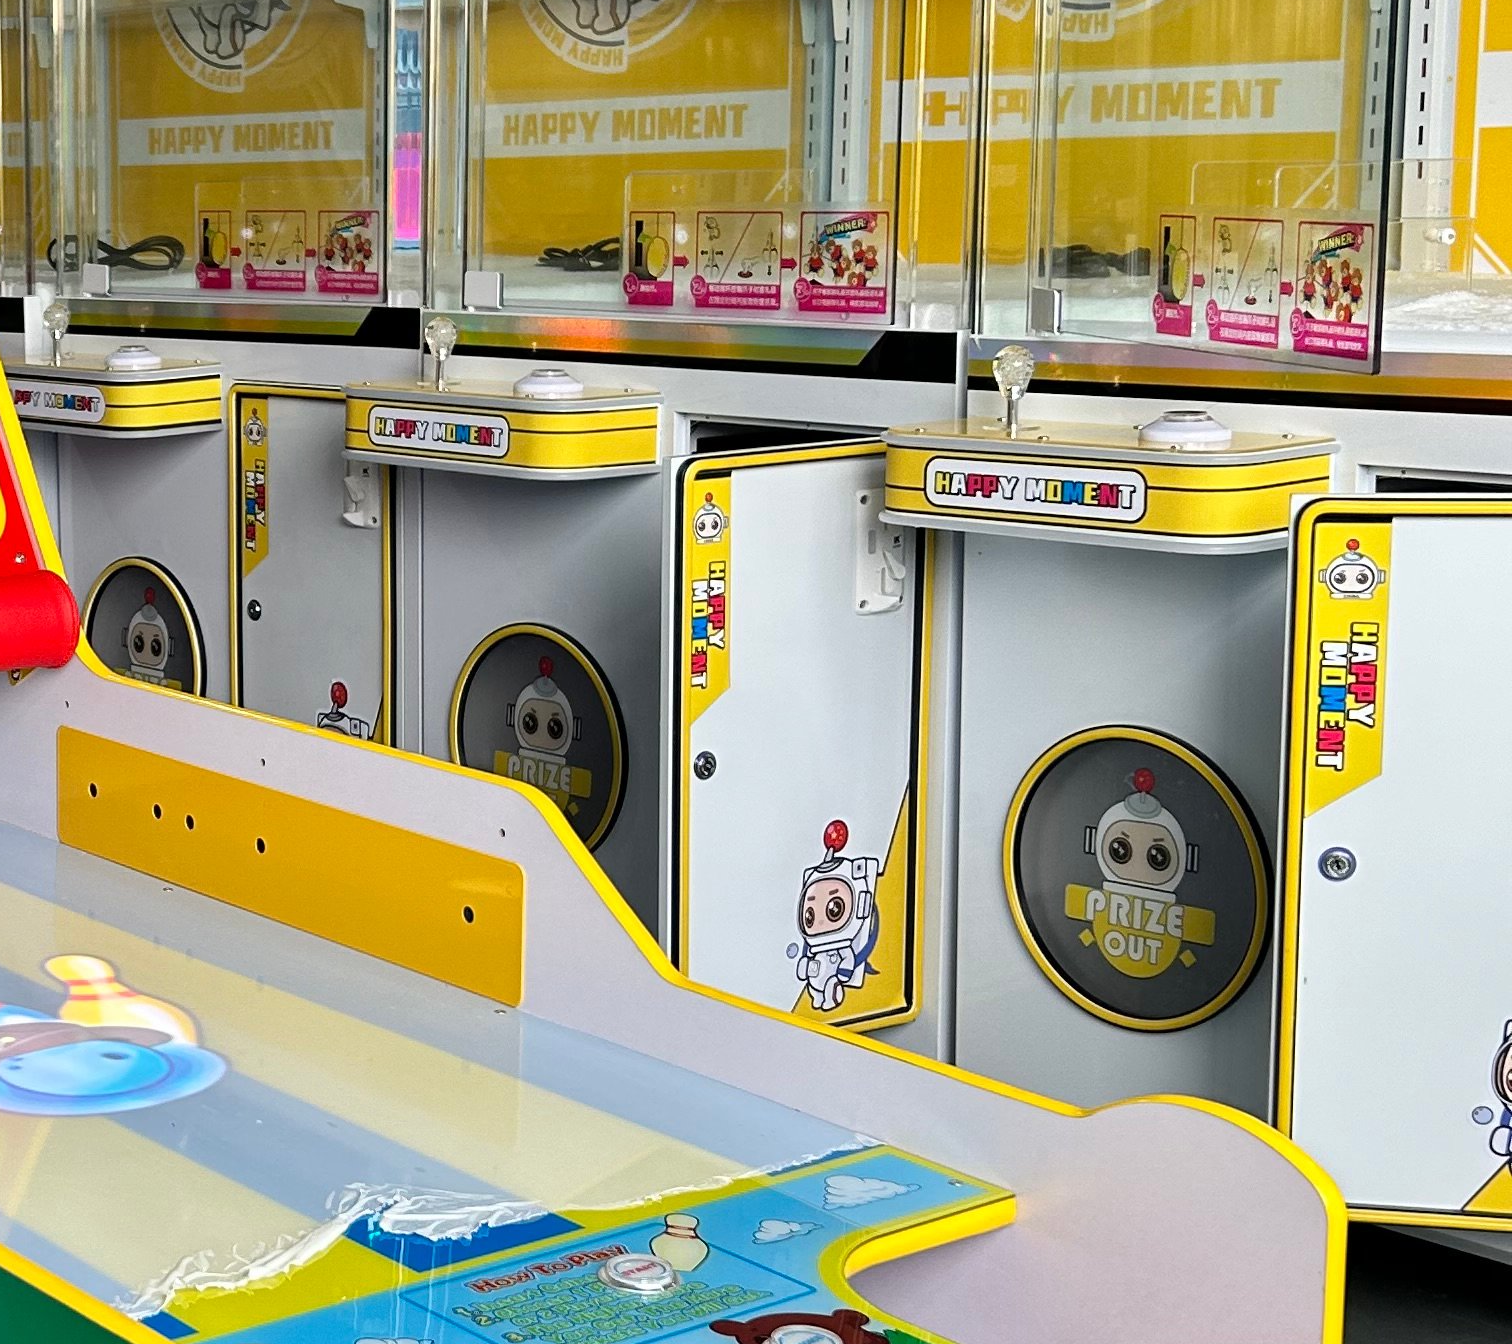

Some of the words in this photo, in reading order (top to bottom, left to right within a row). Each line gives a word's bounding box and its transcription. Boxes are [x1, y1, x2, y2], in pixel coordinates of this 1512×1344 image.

[1090, 77, 1282, 124] MOMENT
[148, 124, 225, 155] HAPPY
[233, 120, 334, 151] MOMENT
[503, 109, 601, 146] HAPPY
[611, 103, 748, 141] MOMENT
[14, 389, 41, 407] PPY
[43, 392, 101, 413] MOMENT
[375, 416, 429, 440] HAPPY
[432, 421, 504, 448] MOMENT
[245, 470, 256, 553] MOMENT
[254, 458, 266, 527] HAPPY
[934, 471, 1019, 500] HAPPY
[1024, 477, 1137, 509] MOMENT
[708, 560, 726, 651] HAPPY
[690, 578, 708, 690] MOMENT
[1346, 621, 1380, 728] HAPPY
[1314, 640, 1349, 772] MOMENT
[508, 754, 571, 793] PRIZE
[1085, 889, 1185, 938] PRIZE
[1103, 930, 1164, 965] OUT
[466, 1269, 535, 1292] How
[529, 1260, 571, 1275] To
[562, 1243, 630, 1265] Play
[622, 1262, 659, 1277] START
